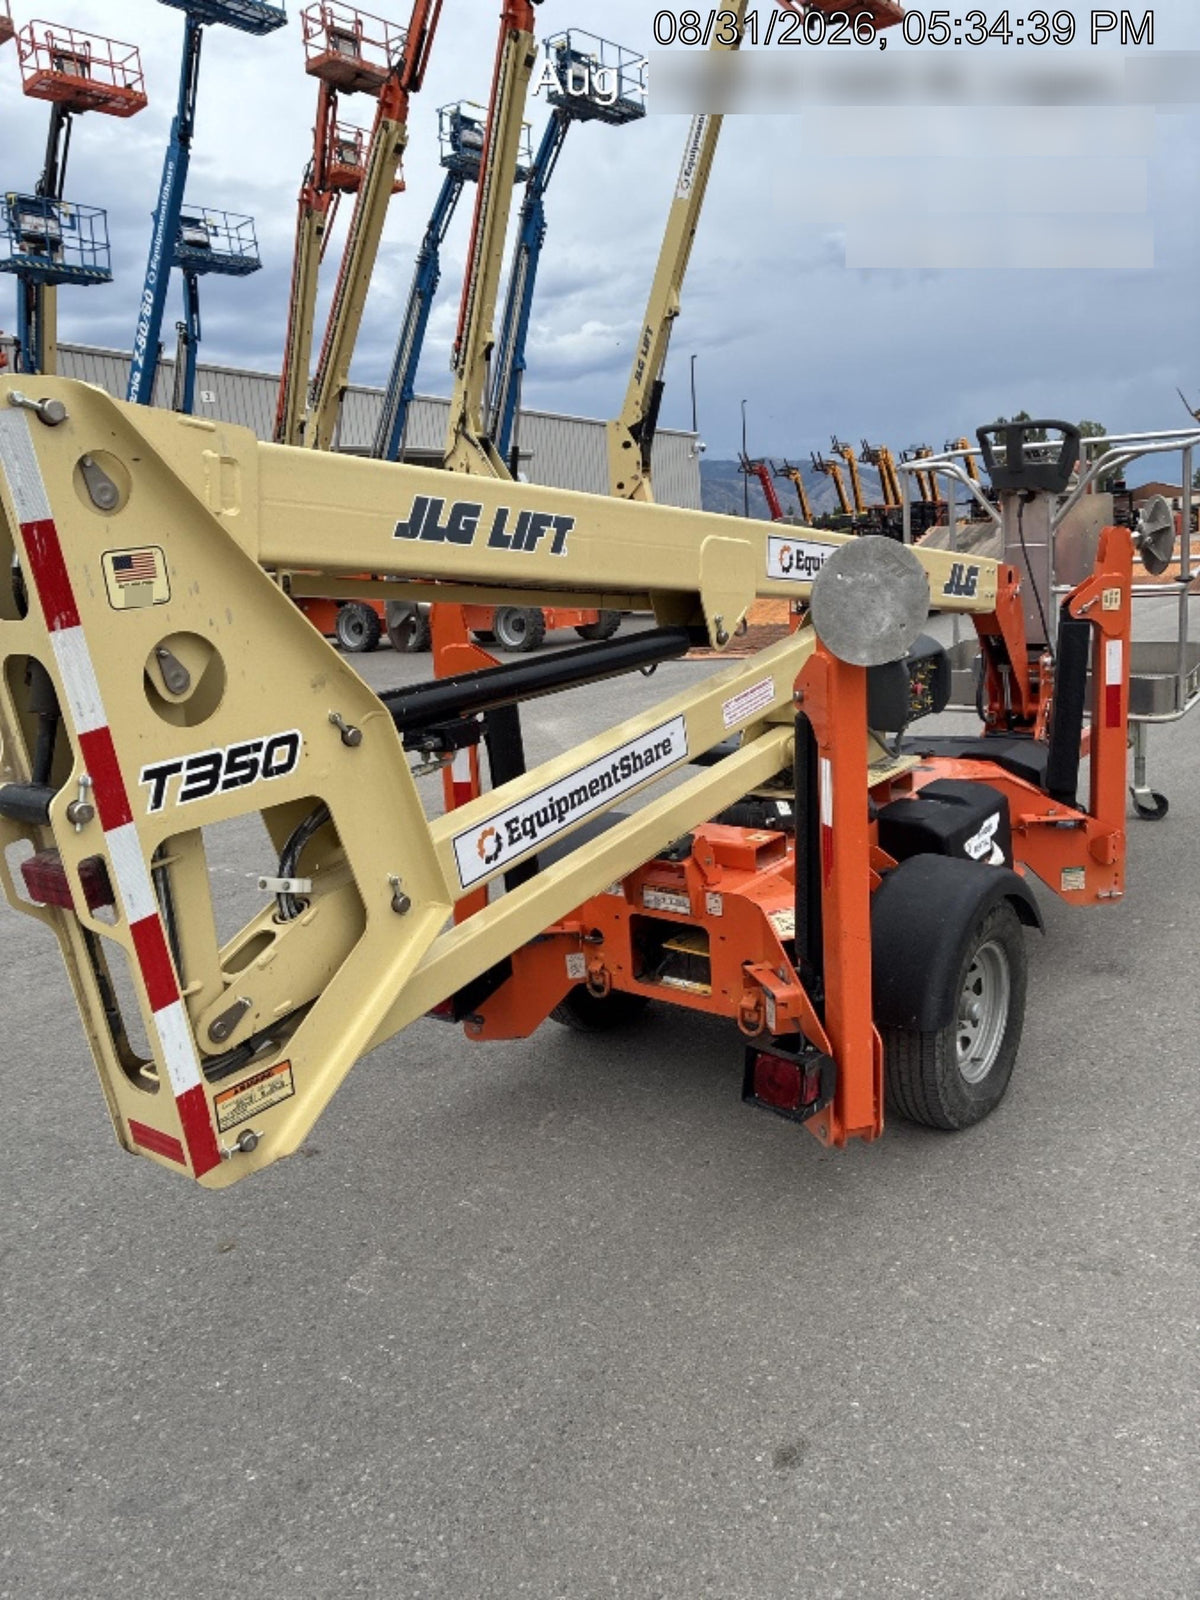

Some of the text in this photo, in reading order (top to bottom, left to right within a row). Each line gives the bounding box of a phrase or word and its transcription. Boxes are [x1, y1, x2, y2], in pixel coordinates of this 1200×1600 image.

[392, 494, 576, 556] JLG LIFT
[942, 562, 980, 597] JLG
[138, 728, 302, 814] T350
[505, 737, 673, 847] EquipmentShare
